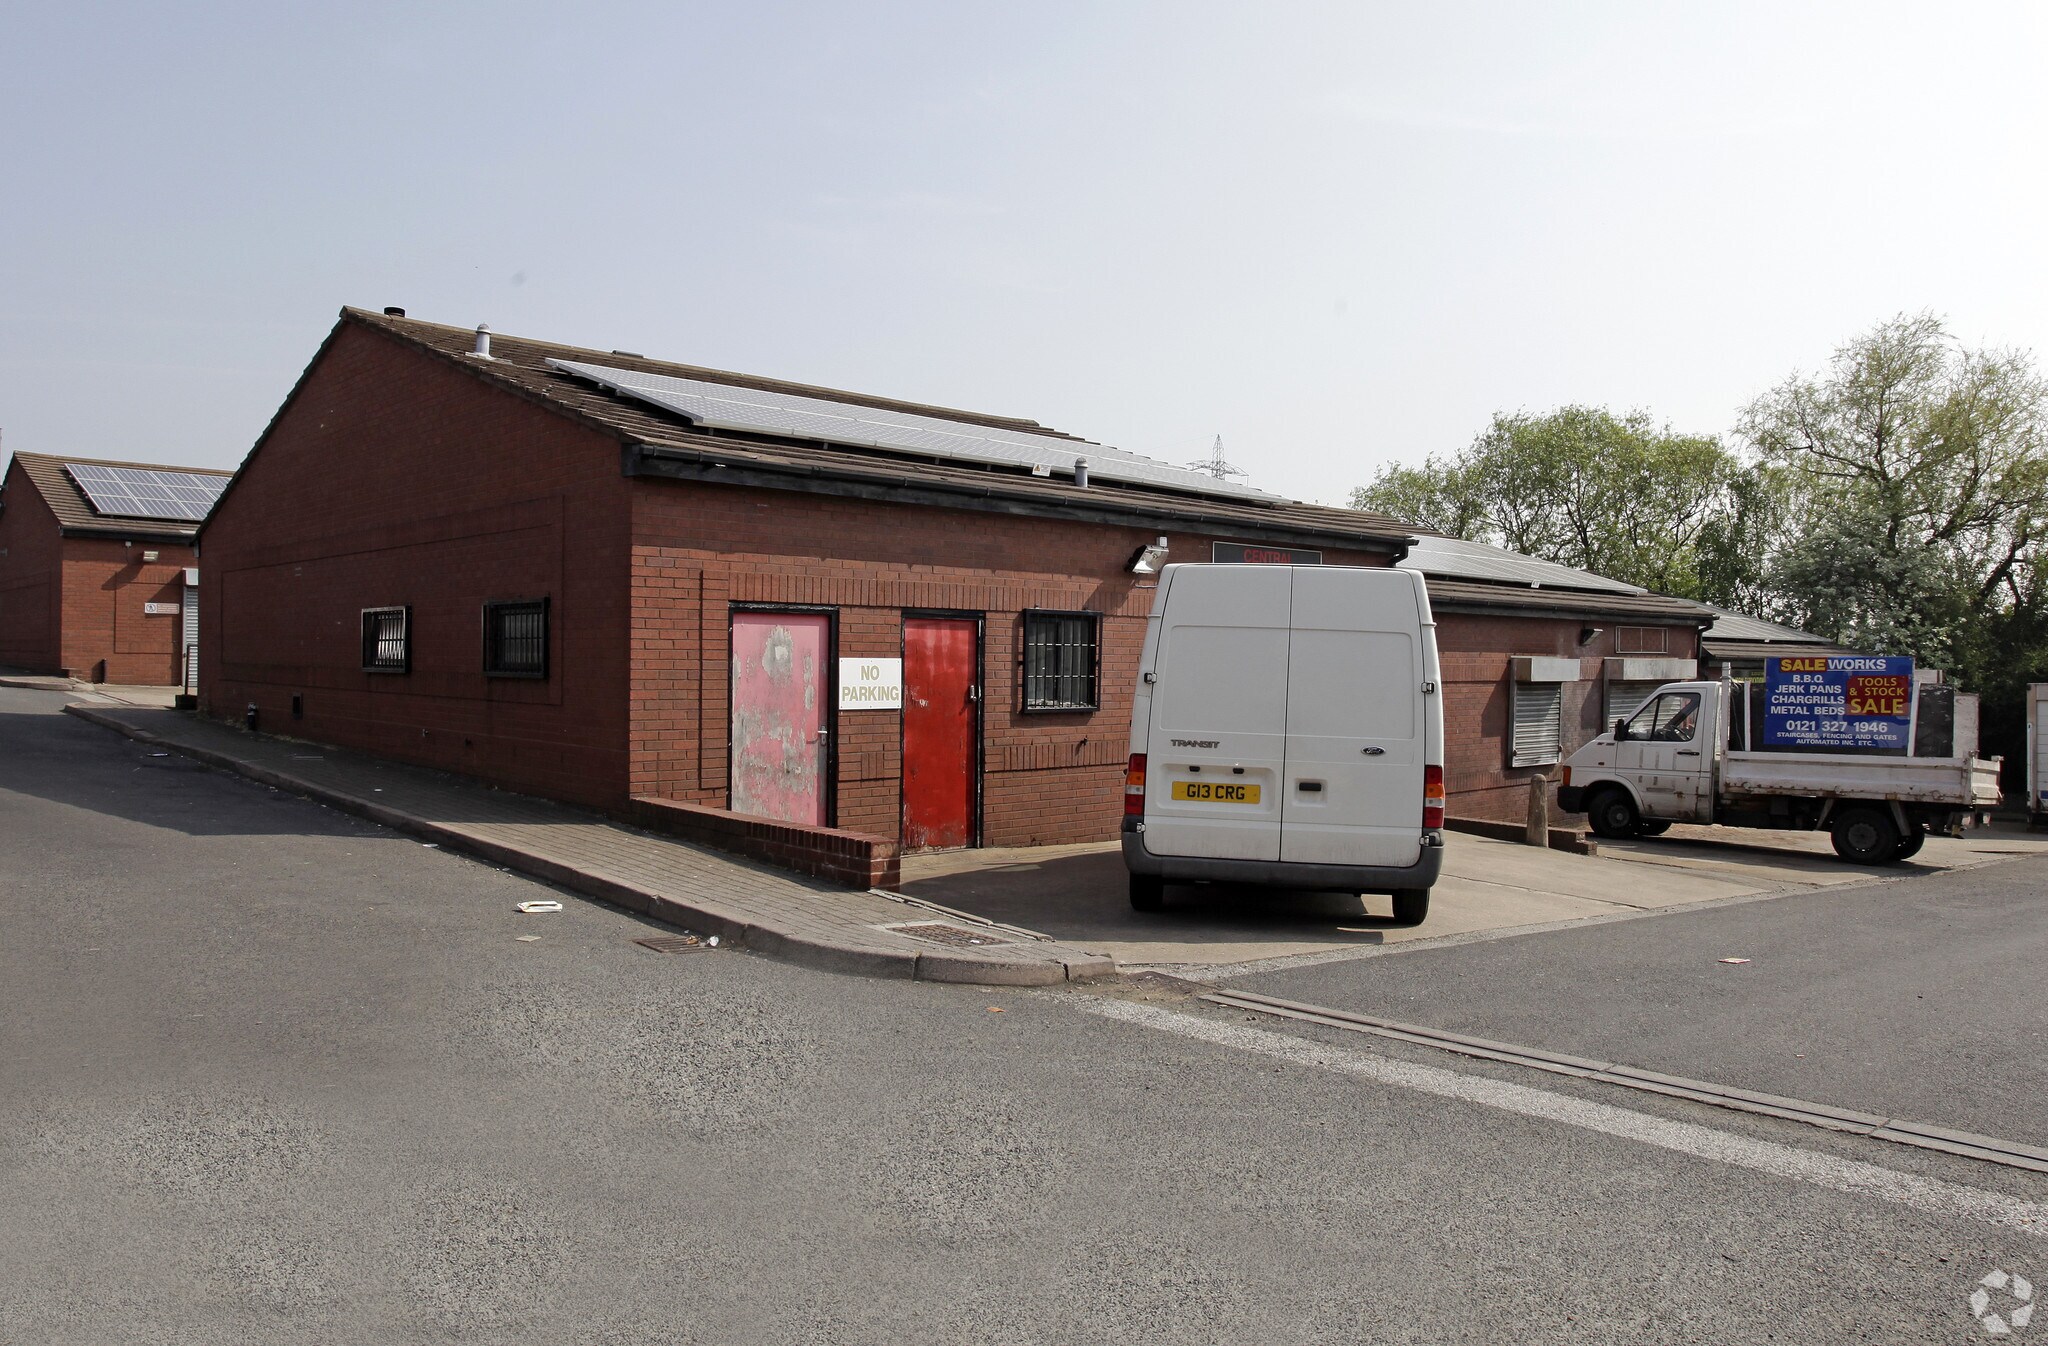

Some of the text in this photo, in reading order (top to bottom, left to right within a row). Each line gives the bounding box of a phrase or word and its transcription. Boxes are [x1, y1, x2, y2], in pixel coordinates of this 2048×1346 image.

[1780, 659, 1887, 671] SALE WORKS
[860, 665, 880, 681] NO
[1793, 675, 1823, 683] B.B.Q
[1858, 677, 1897, 686] TOOLS
[1775, 685, 1842, 693] JERK PANS
[1850, 687, 1904, 696] & STOCK
[842, 686, 899, 702] PARKING
[1771, 695, 1845, 704] CHARGRILLS
[1770, 706, 1845, 715] METAL BEDS
[1850, 699, 1903, 714] SALE
[1786, 720, 1888, 733] 0121 327 1946
[1171, 739, 1220, 748] TRANSIT
[1796, 738, 1840, 746] AUTOMATED
[1187, 784, 1245, 800] G13 CRG
